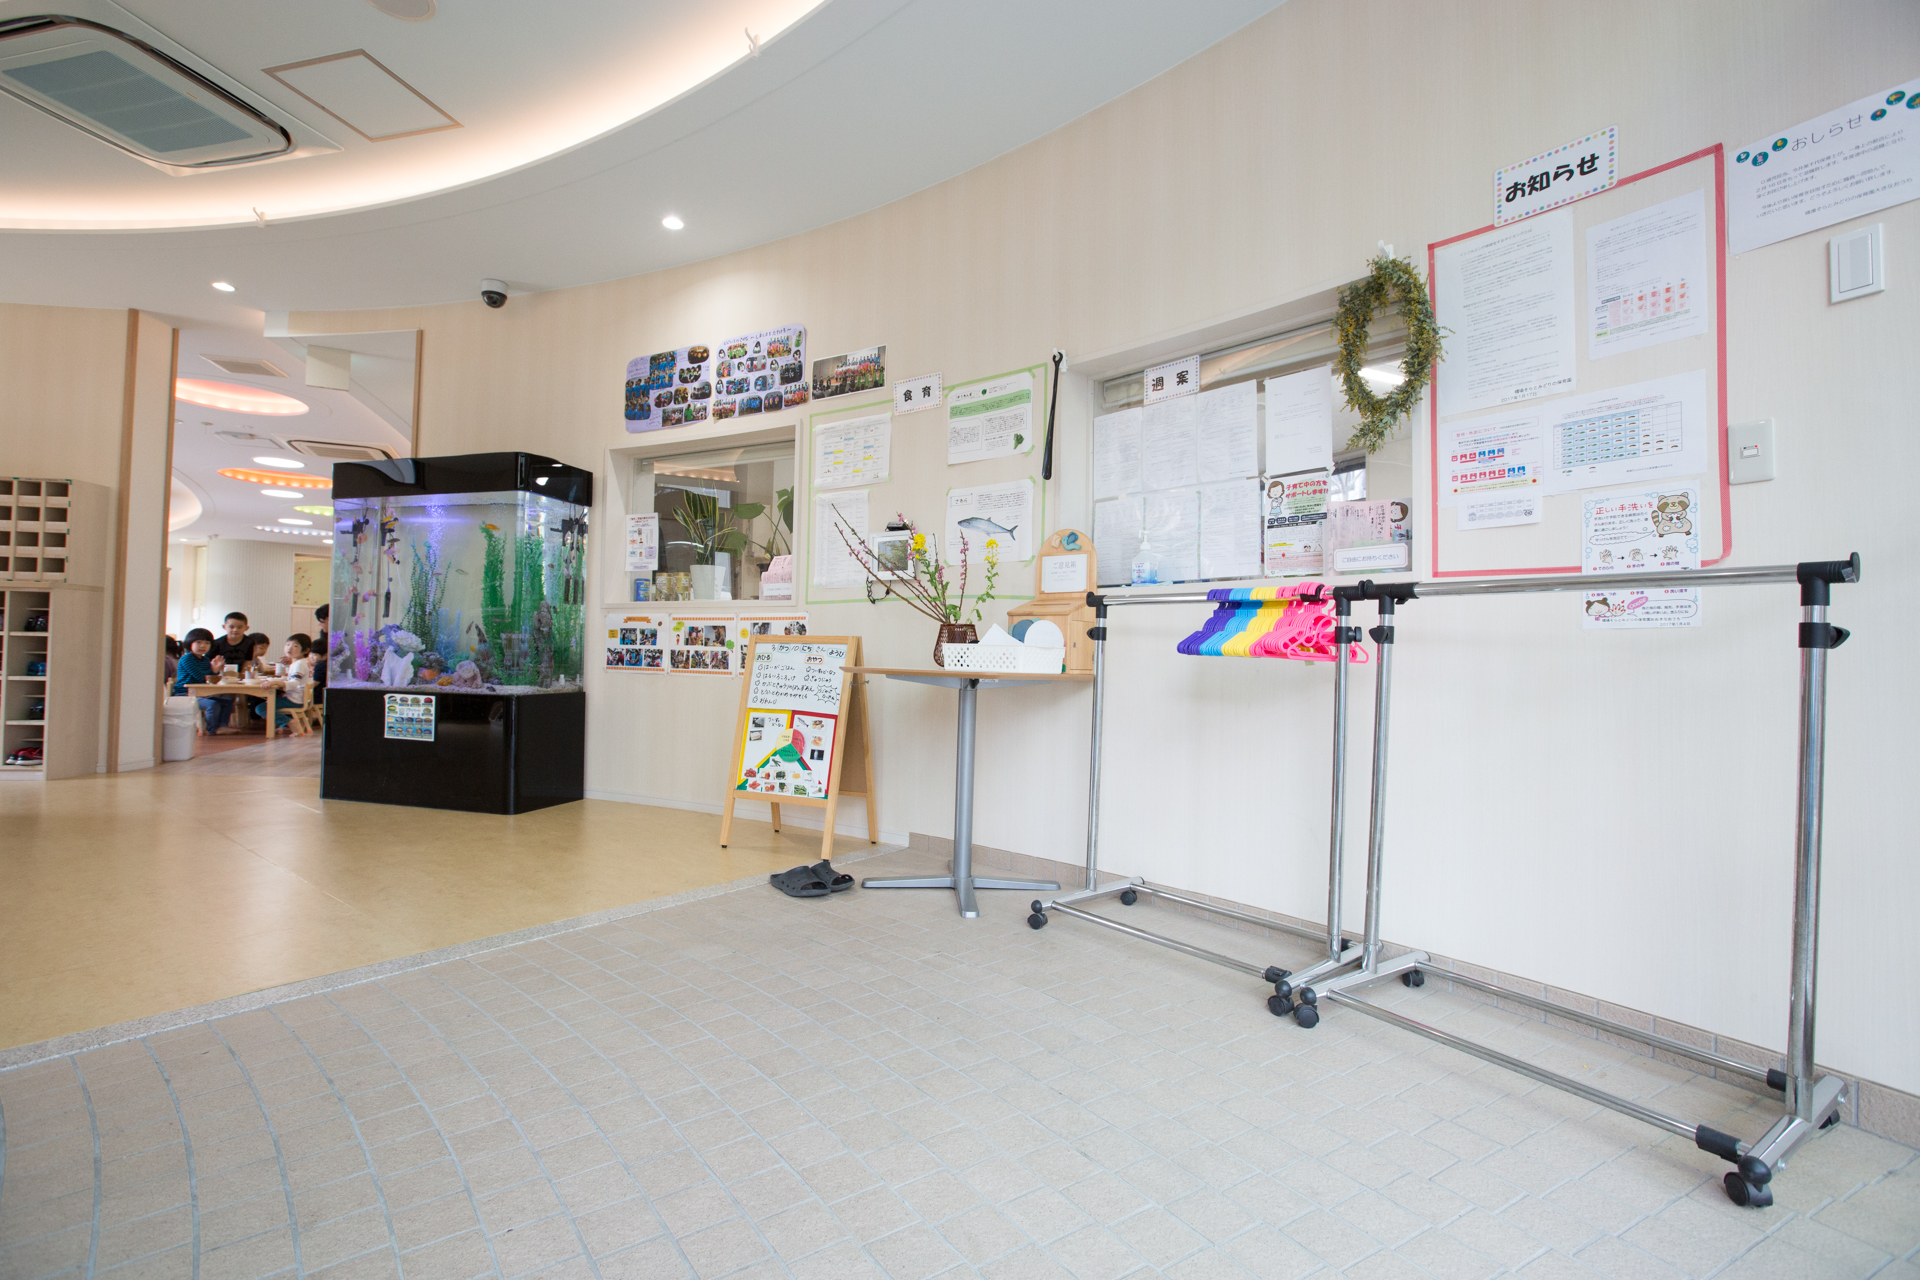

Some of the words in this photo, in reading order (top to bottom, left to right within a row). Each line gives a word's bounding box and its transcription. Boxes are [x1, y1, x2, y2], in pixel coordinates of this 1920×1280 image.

[1791, 113, 1863, 152] おしらせ
[1505, 152, 1600, 203] お知らせ
[1151, 370, 1189, 393] 週案
[903, 385, 931, 402] 食育
[1285, 480, 1328, 491] 子育て中の方を
[1595, 501, 1653, 515] 正しい手洗いを
[1053, 560, 1077, 570] ご意見箱
[1342, 554, 1400, 564] ご自由にお持ちください
